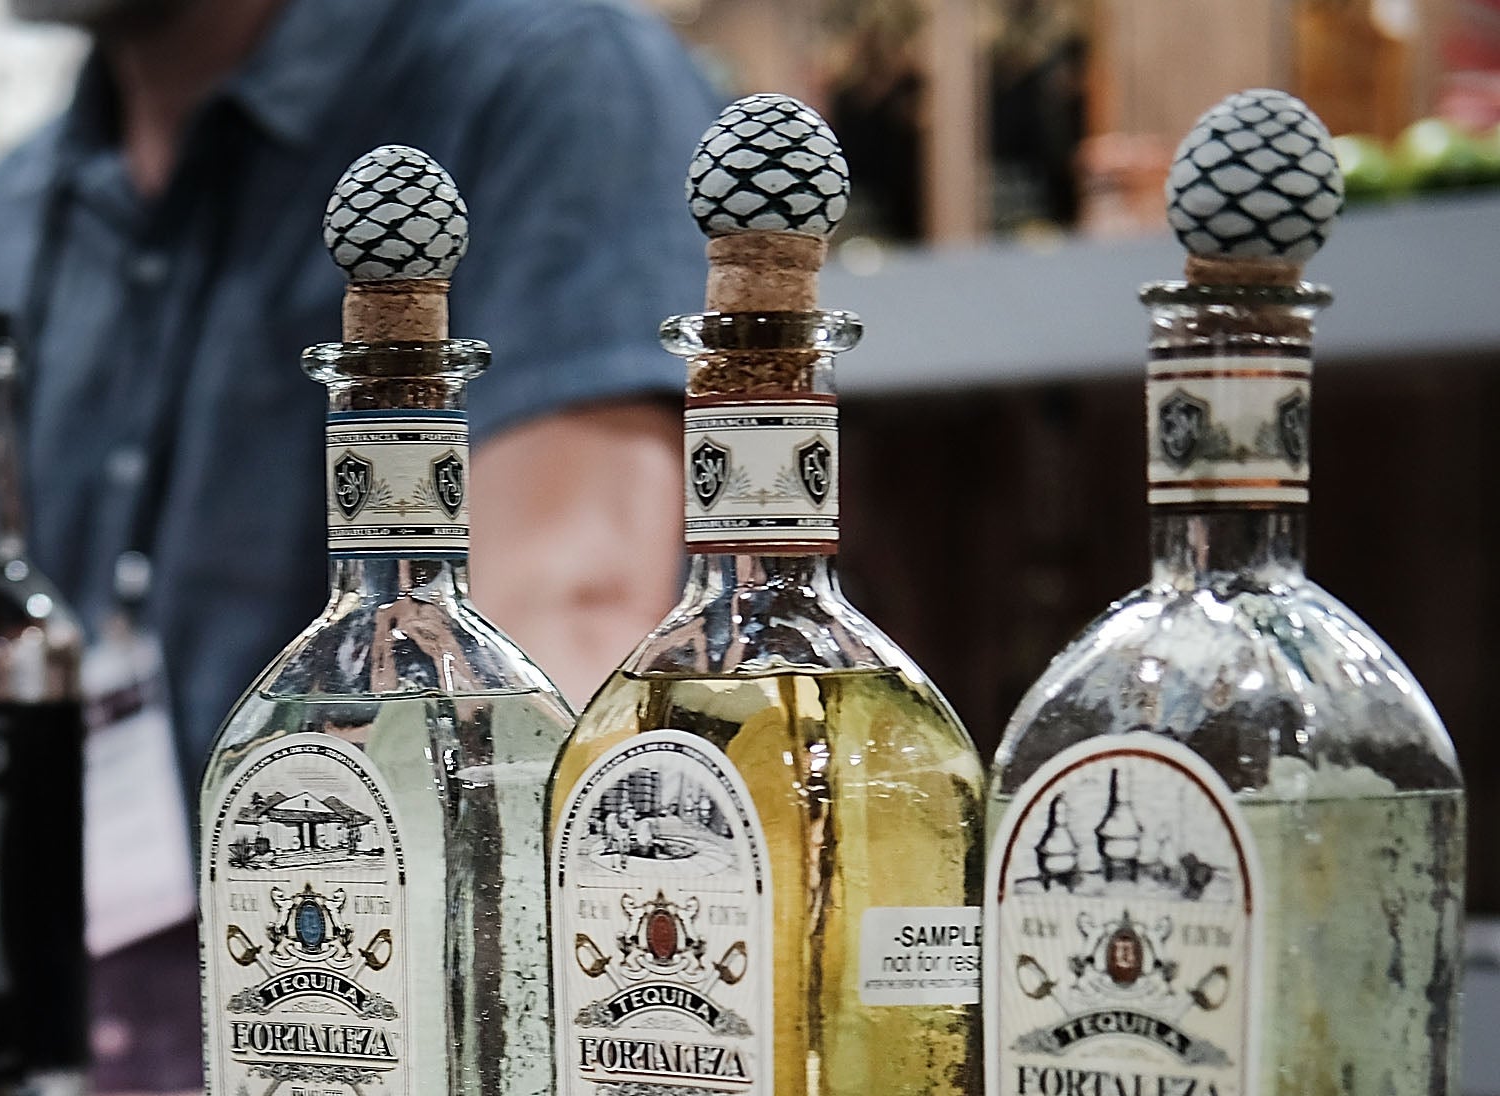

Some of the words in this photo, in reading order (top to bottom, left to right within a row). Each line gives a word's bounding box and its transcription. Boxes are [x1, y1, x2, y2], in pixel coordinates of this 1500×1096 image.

[883, 953, 911, 972] not
[917, 950, 941, 972] for
[264, 974, 360, 1004] TEQUILA
[614, 988, 713, 1022] TEQUILA
[230, 1021, 397, 1057] FORTALEZA
[1065, 1013, 1181, 1049] TEQUILA
[578, 1036, 747, 1078] FORTALEZA
